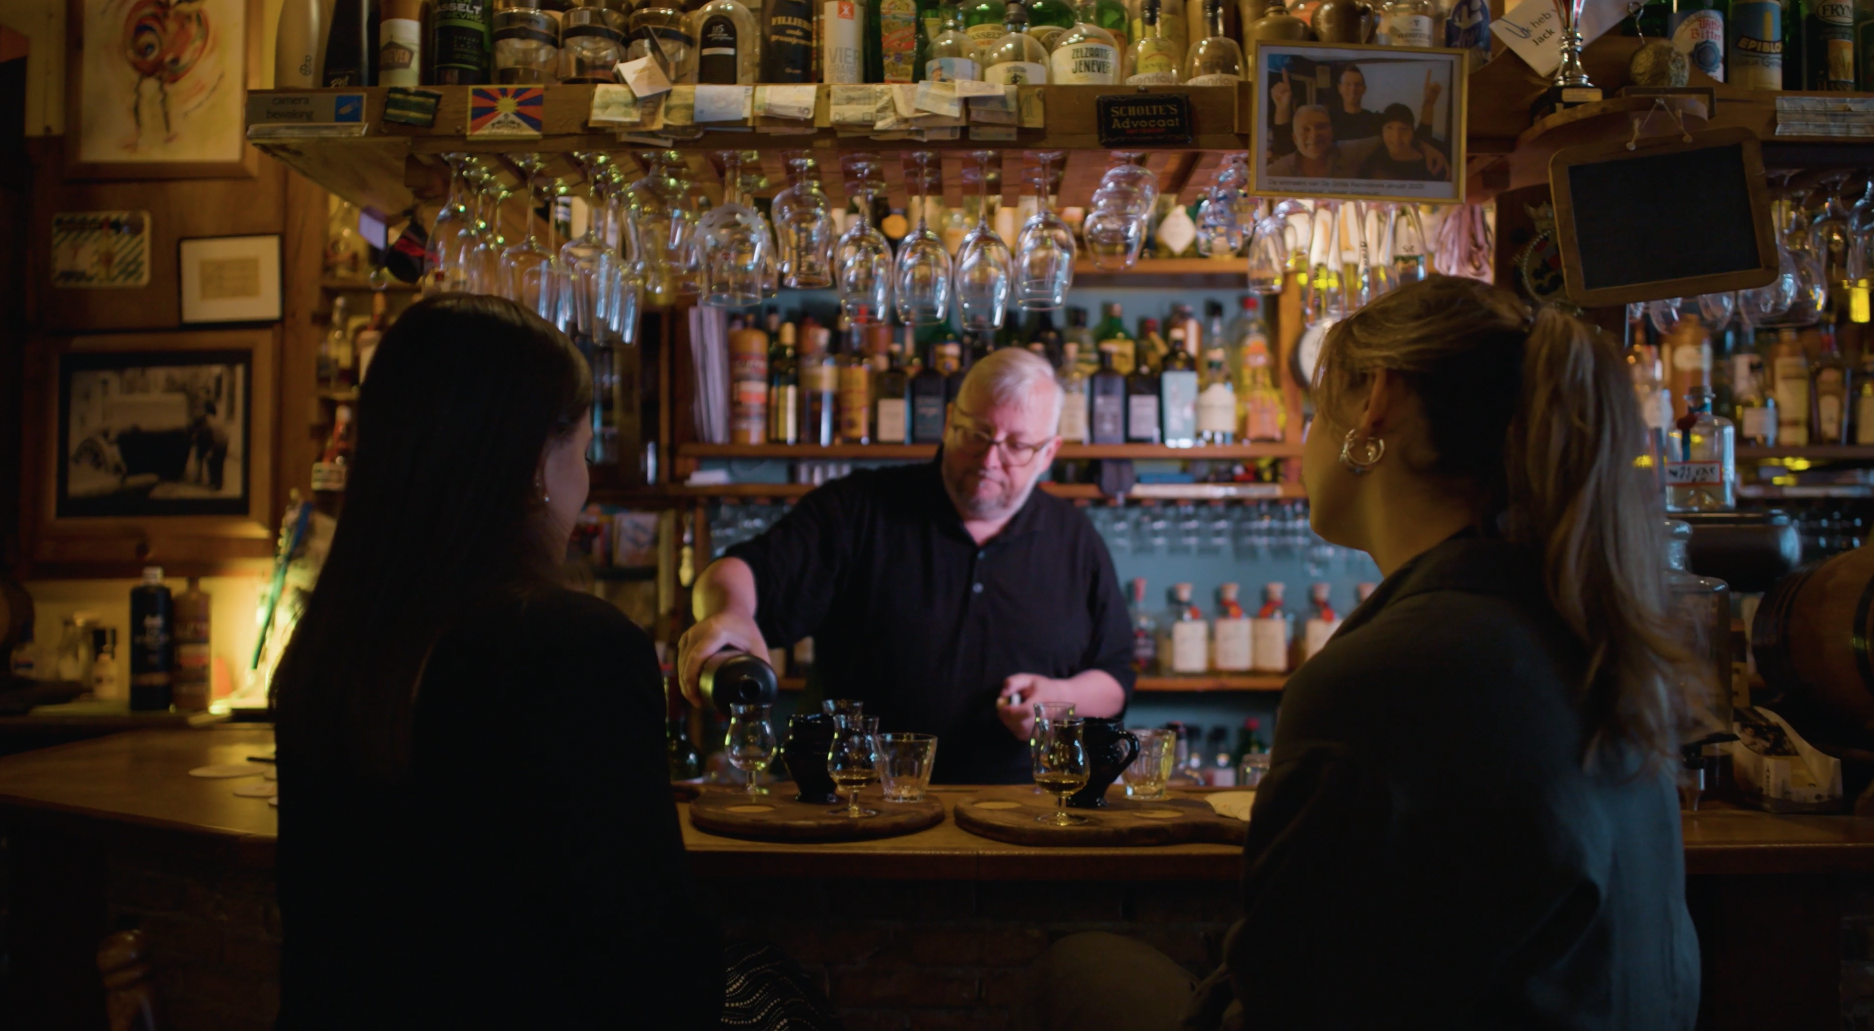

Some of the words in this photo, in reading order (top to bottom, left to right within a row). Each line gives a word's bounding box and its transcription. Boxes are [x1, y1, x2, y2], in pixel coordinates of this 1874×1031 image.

[1530, 12, 1552, 28] heb
[1532, 29, 1555, 46] Jack
[1072, 60, 1112, 74] JENEVER
[272, 97, 309, 105] camera
[266, 109, 314, 122] bewaking
[1110, 104, 1178, 118] SCHOLTE'S
[1111, 118, 1180, 129] Advocaat
